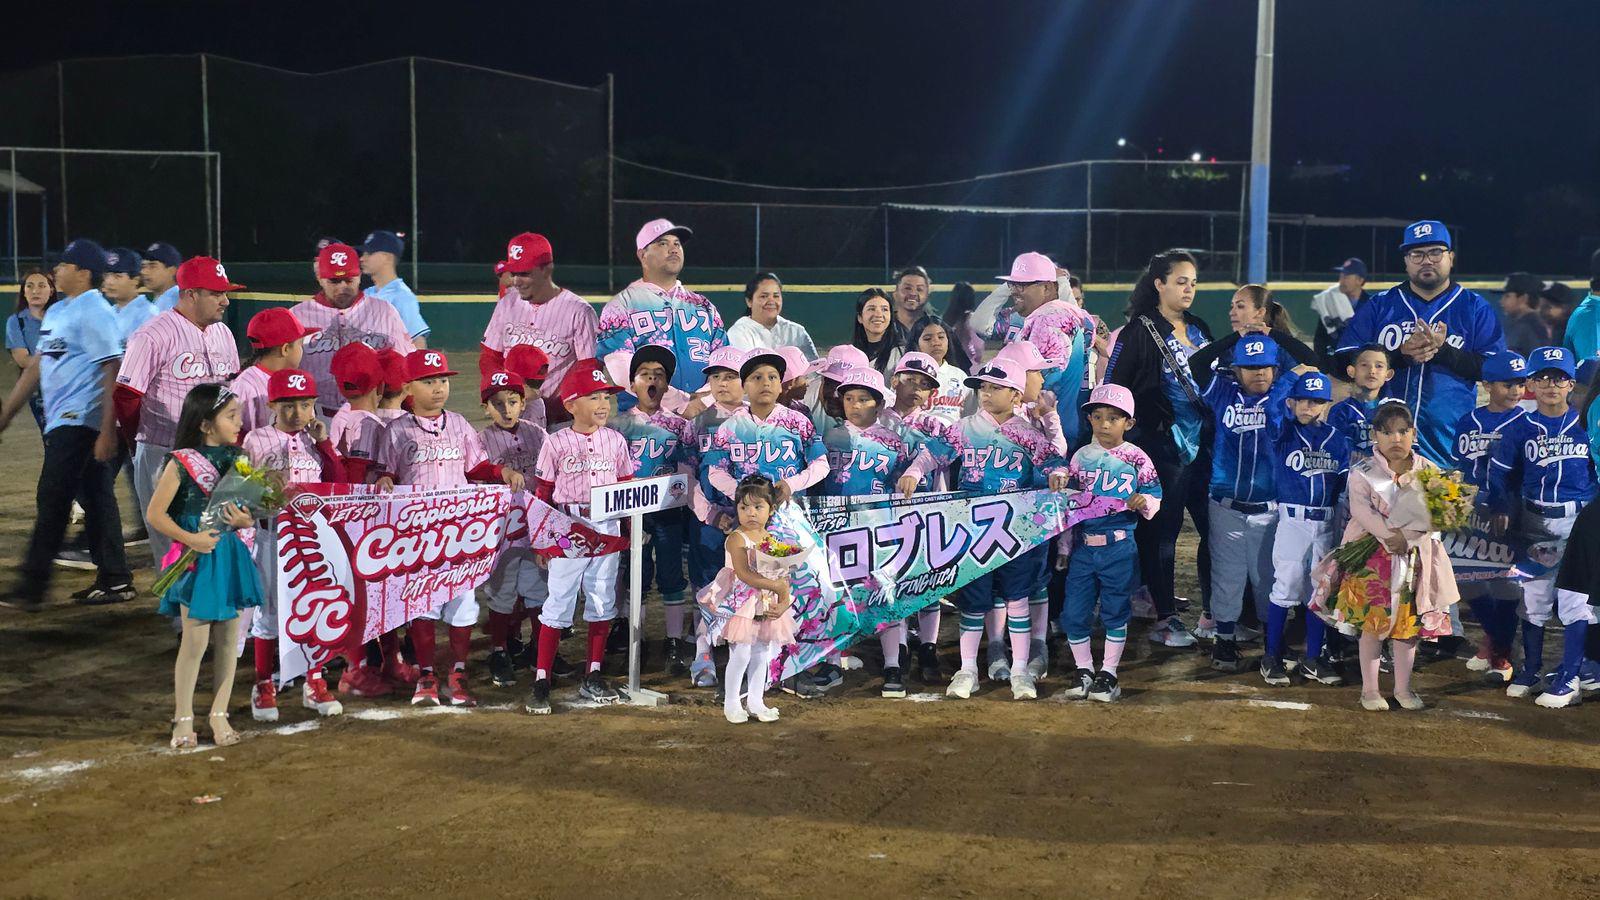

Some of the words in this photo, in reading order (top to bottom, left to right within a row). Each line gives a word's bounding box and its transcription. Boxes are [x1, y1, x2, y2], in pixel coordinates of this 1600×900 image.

[730, 440, 798, 464] ロブレス
[963, 445, 1025, 473] ロブレス
[871, 478, 885, 494] 5
[827, 500, 1021, 584] ロブレス
[288, 588, 350, 642] TC
